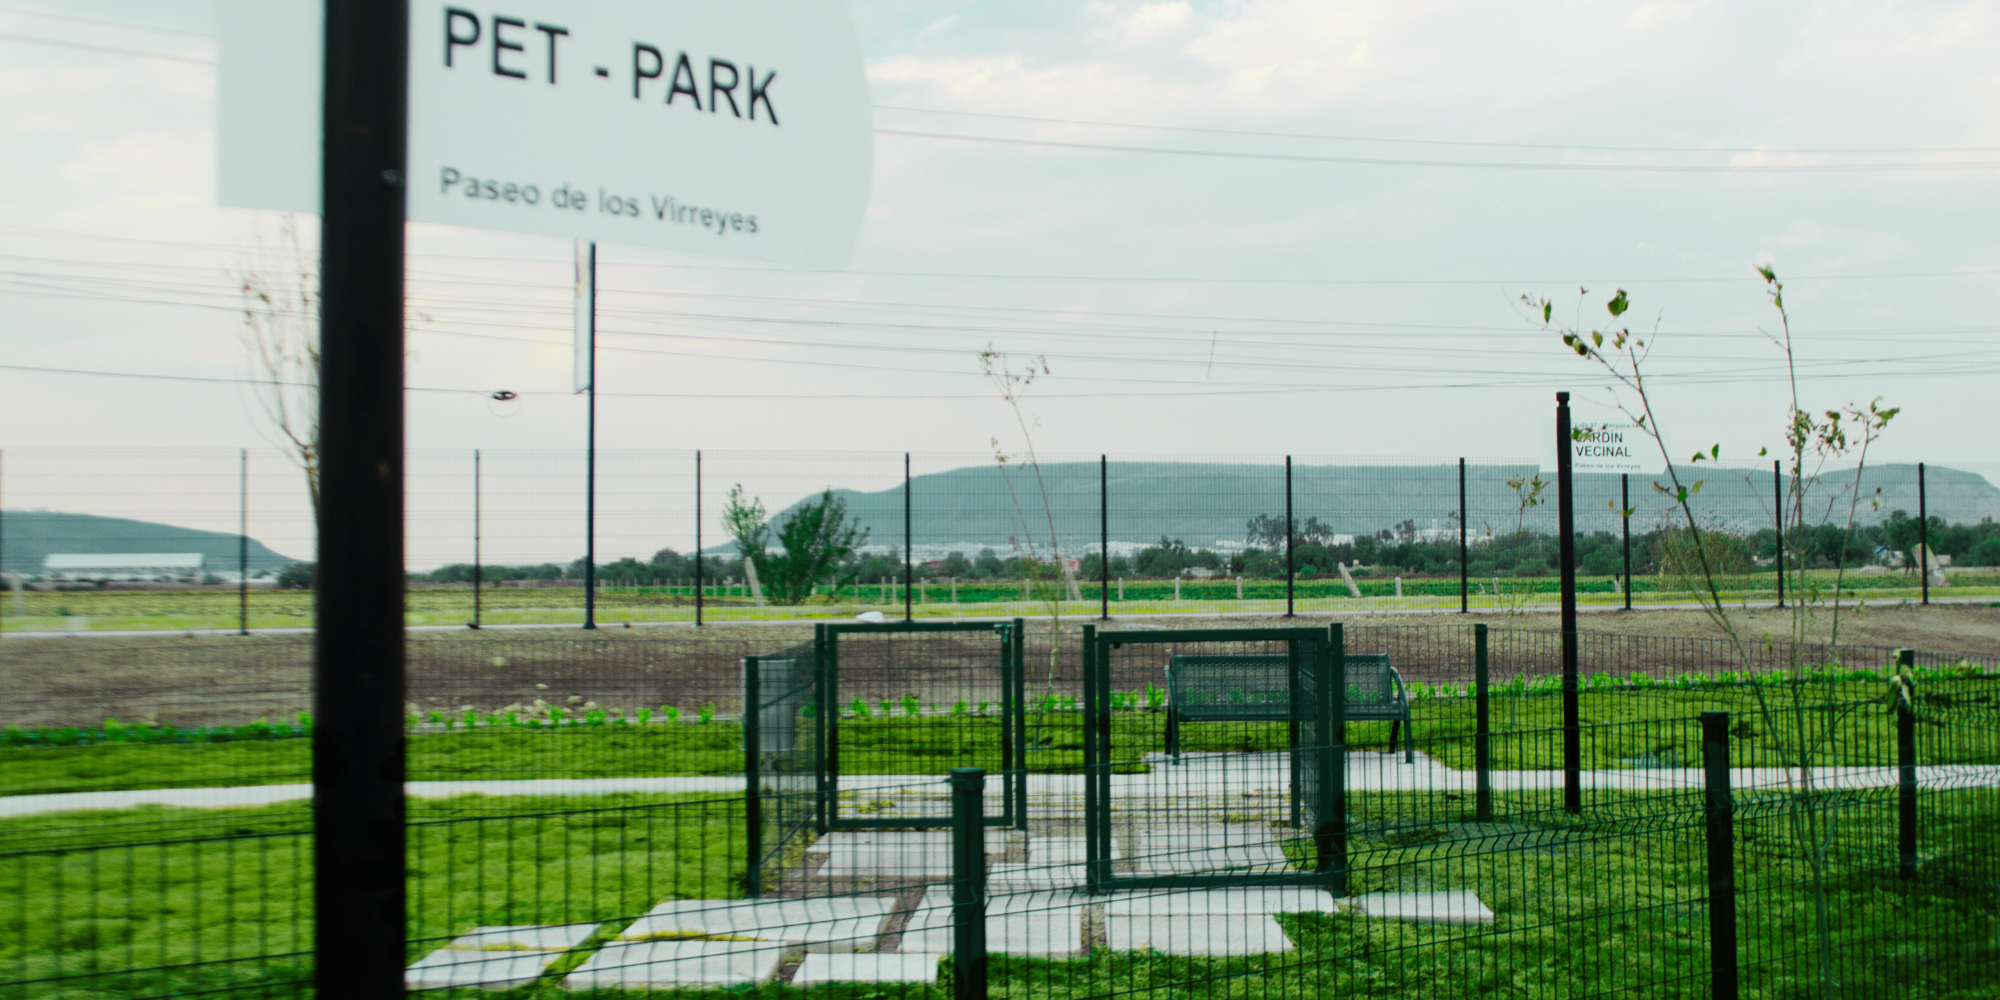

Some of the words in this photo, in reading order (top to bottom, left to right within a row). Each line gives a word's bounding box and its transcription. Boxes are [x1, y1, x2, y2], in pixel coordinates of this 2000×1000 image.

[443, 6, 569, 85] PET
[593, 64, 610, 78] -
[630, 40, 779, 125] PARK
[440, 166, 540, 205] Paseo
[551, 183, 588, 211] de
[598, 186, 641, 217] los
[650, 193, 759, 235] Virreyes
[1575, 445, 1631, 457] VECINAL
